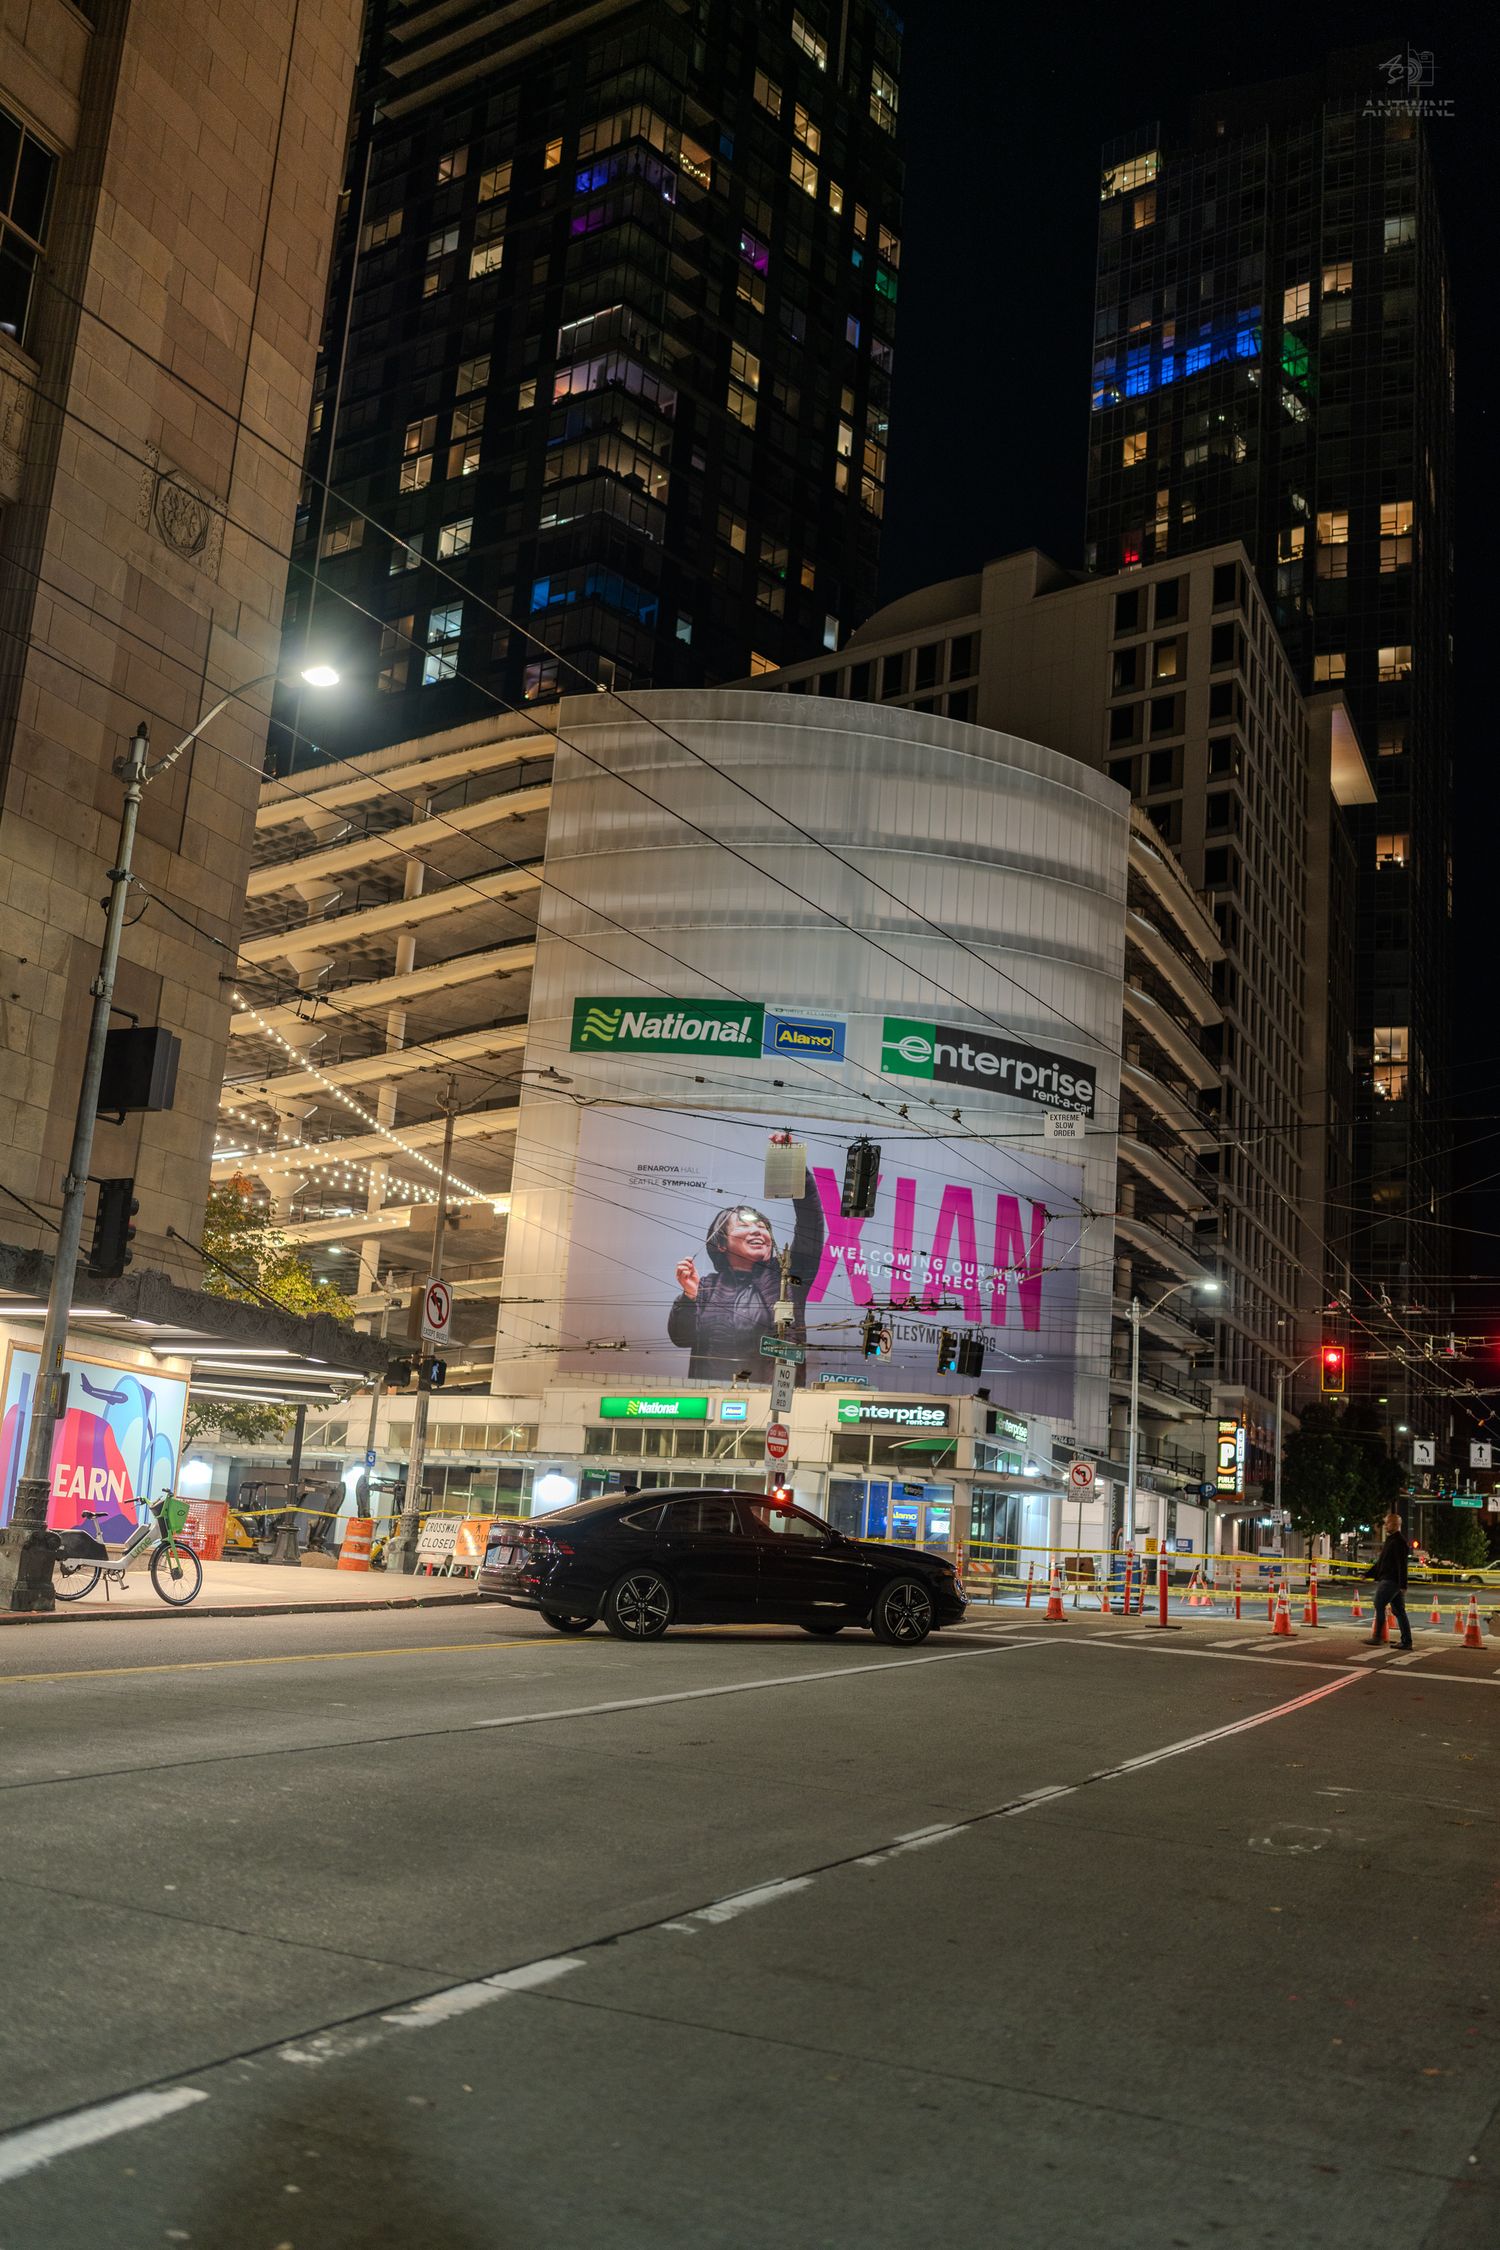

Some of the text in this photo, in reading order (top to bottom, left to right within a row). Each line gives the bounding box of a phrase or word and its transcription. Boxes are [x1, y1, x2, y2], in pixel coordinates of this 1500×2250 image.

[778, 1029, 832, 1047] Alamo
[884, 1035, 1093, 1101] enterprise
[1032, 1087, 1092, 1114] rent-a-car
[1049, 1113, 1080, 1122] EXTREME
[1055, 1121, 1074, 1129] SLOW
[1053, 1129, 1076, 1137] ORDER
[637, 1164, 680, 1173] BENAROYA
[662, 1178, 707, 1188] SYMPHONY
[806, 1166, 1046, 1332] XIAN
[830, 1245, 1027, 1285] WELCOMING OUR NEW
[853, 1262, 1007, 1297] MUSIC DIRECTOR
[858, 1319, 997, 1353] SLESYMPONRG
[780, 1369, 791, 1379] NO
[777, 1380, 790, 1389] TURN
[778, 1390, 786, 1398] ON
[776, 1399, 786, 1407] RED
[840, 1403, 946, 1423] enterprise
[1220, 1443, 1235, 1467] P
[52, 1463, 126, 1503] EARN
[425, 1521, 458, 1534] CROSSWAL
[421, 1537, 456, 1550] CLOSED
